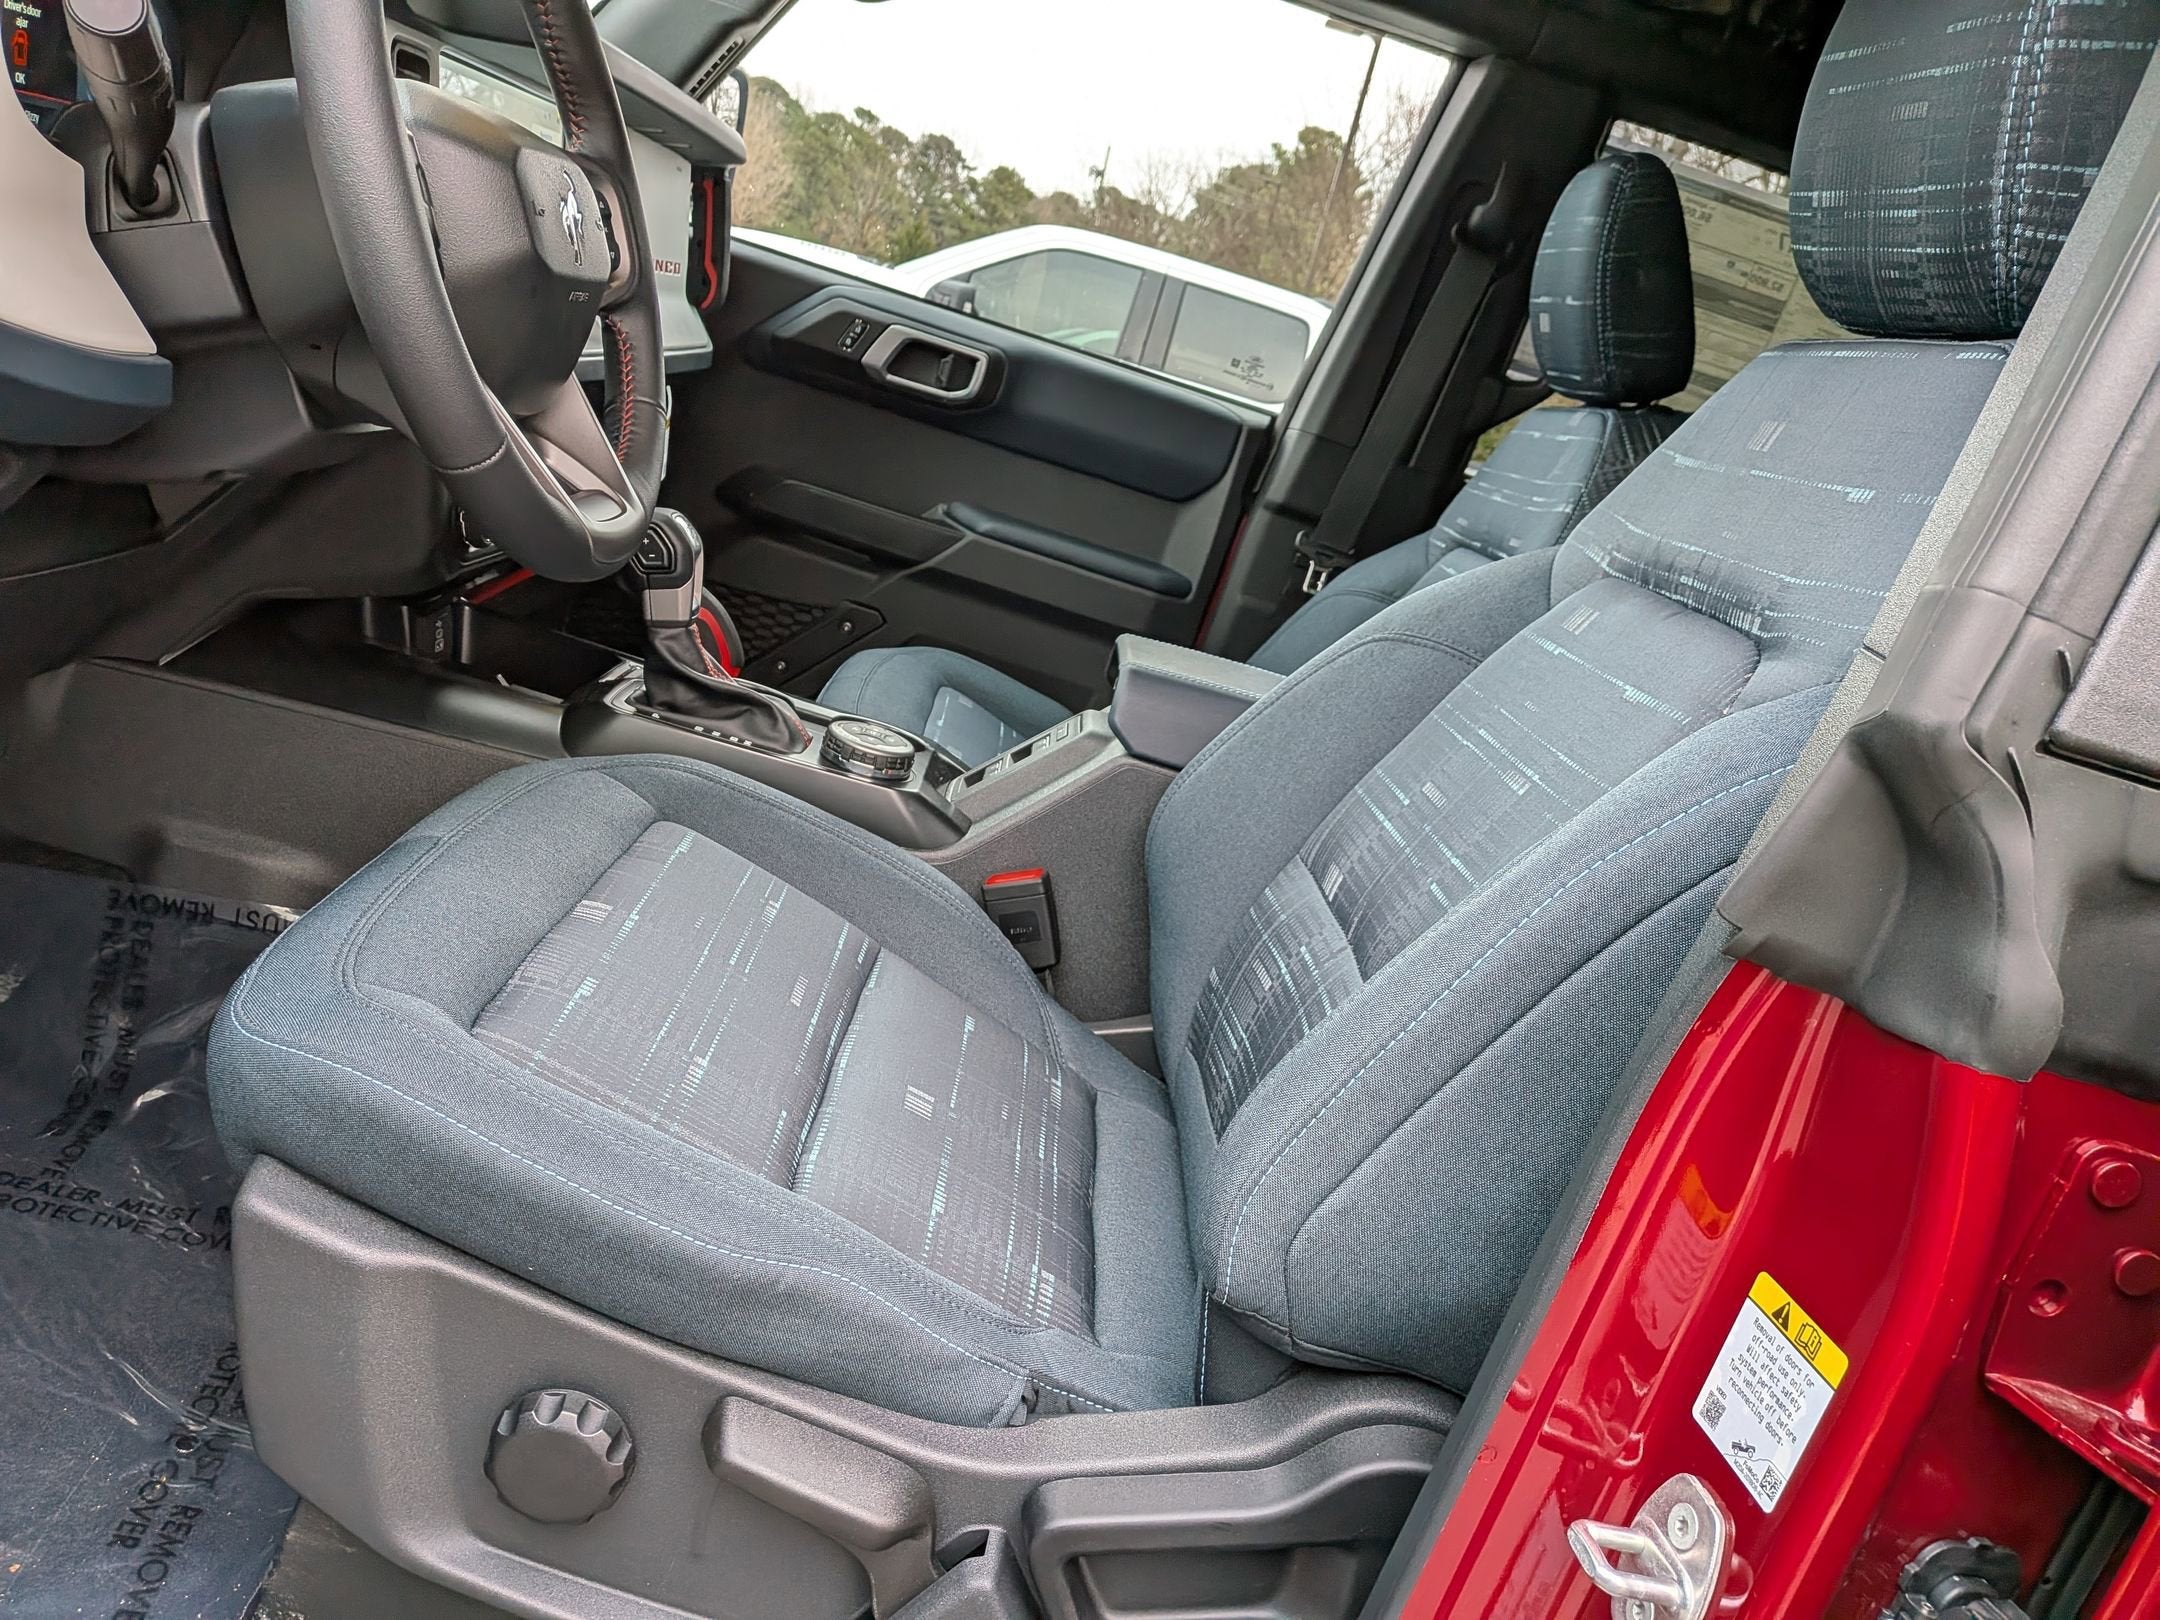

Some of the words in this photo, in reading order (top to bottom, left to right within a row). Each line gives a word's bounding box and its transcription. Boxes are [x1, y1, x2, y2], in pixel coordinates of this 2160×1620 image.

[16, 16, 28, 29] ajar
[27, 4, 41, 17] door
[15, 72, 25, 84] OK
[654, 258, 681, 274] NCO
[231, 907, 291, 933] UST
[0, 1170, 102, 1204] DEALER
[116, 1198, 201, 1224] MUST
[1746, 1344, 1760, 1363] Will
[1760, 1362, 1781, 1387] affect
[1780, 1386, 1802, 1413] safety
[1752, 1335, 1778, 1365] off-road
[1778, 1364, 1790, 1379] use
[1789, 1378, 1806, 1398] only.
[1753, 1317, 1776, 1346] Removal
[1776, 1344, 1785, 1354] of
[1785, 1354, 1802, 1376] doors
[1803, 1373, 1815, 1389] for
[1728, 1377, 1765, 1424] reconnecting
[1765, 1421, 1784, 1446] doors.
[1729, 1358, 1743, 1378] Turn
[1743, 1376, 1765, 1405] vehicle
[1764, 1403, 1777, 1417] off
[1776, 1415, 1797, 1444] before
[1738, 1354, 1757, 1377] system
[1757, 1377, 1794, 1422] performance.
